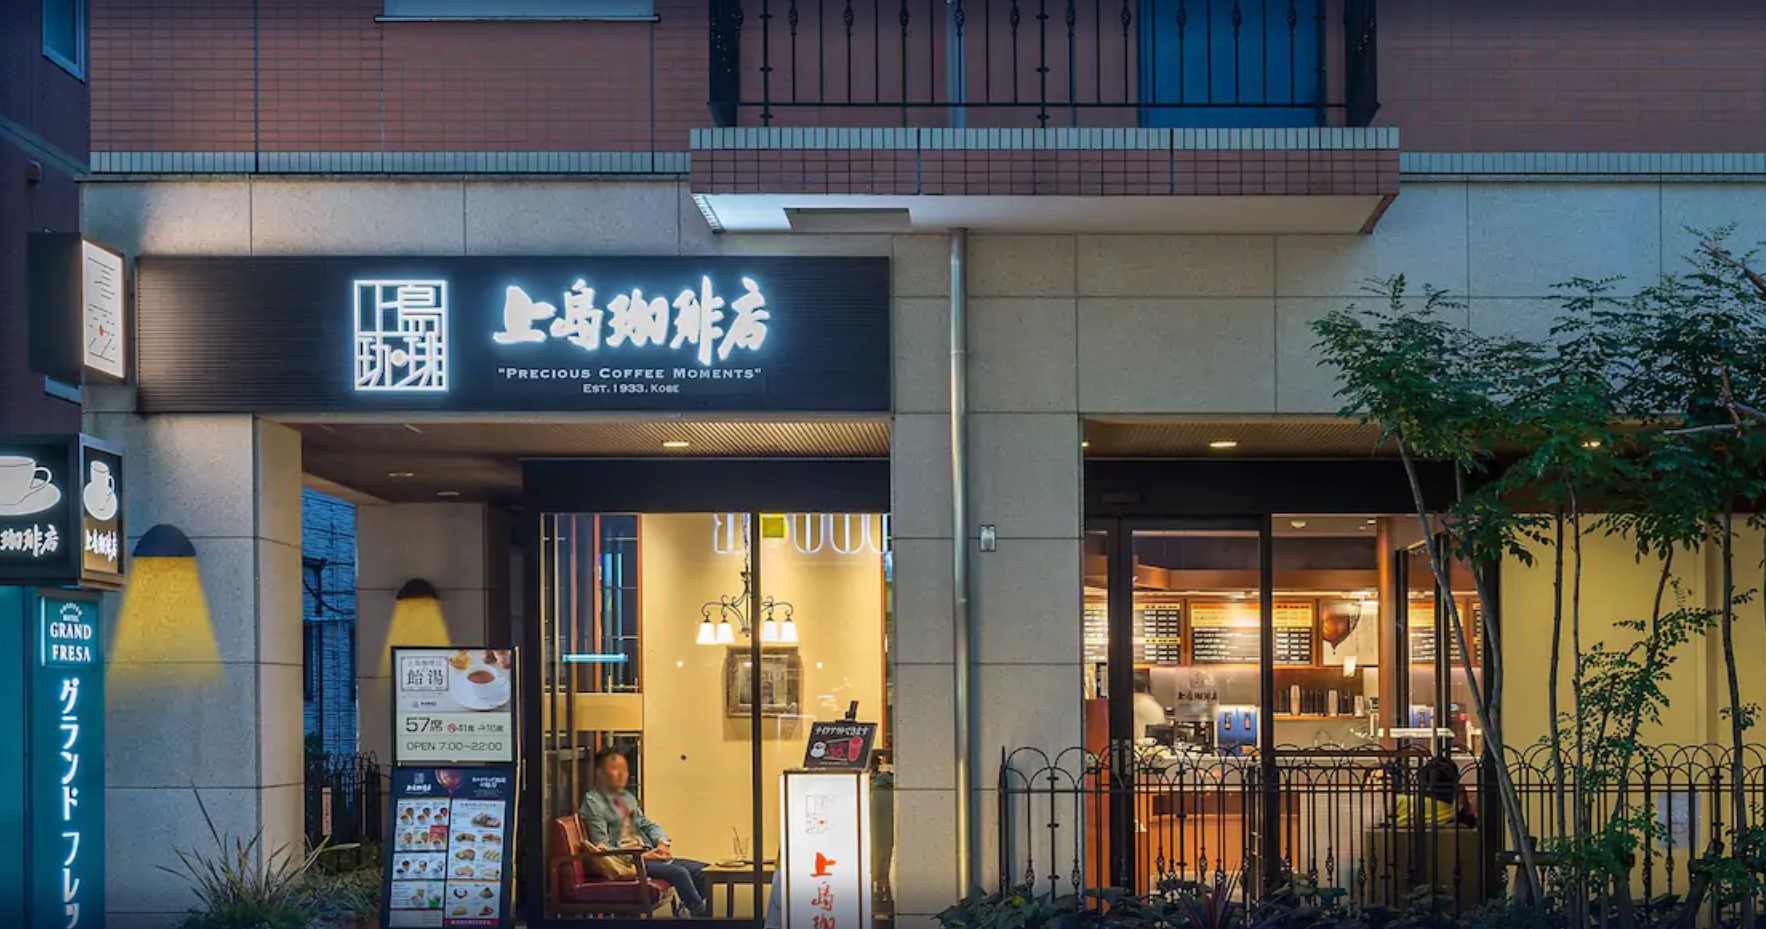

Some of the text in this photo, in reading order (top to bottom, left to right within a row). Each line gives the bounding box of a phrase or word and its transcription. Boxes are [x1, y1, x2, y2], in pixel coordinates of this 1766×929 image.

[493, 275, 770, 366] 上島珈琲店
[50, 622, 92, 640] GRAND
[52, 644, 91, 662] FRESA
[406, 741, 435, 751] OPEN
